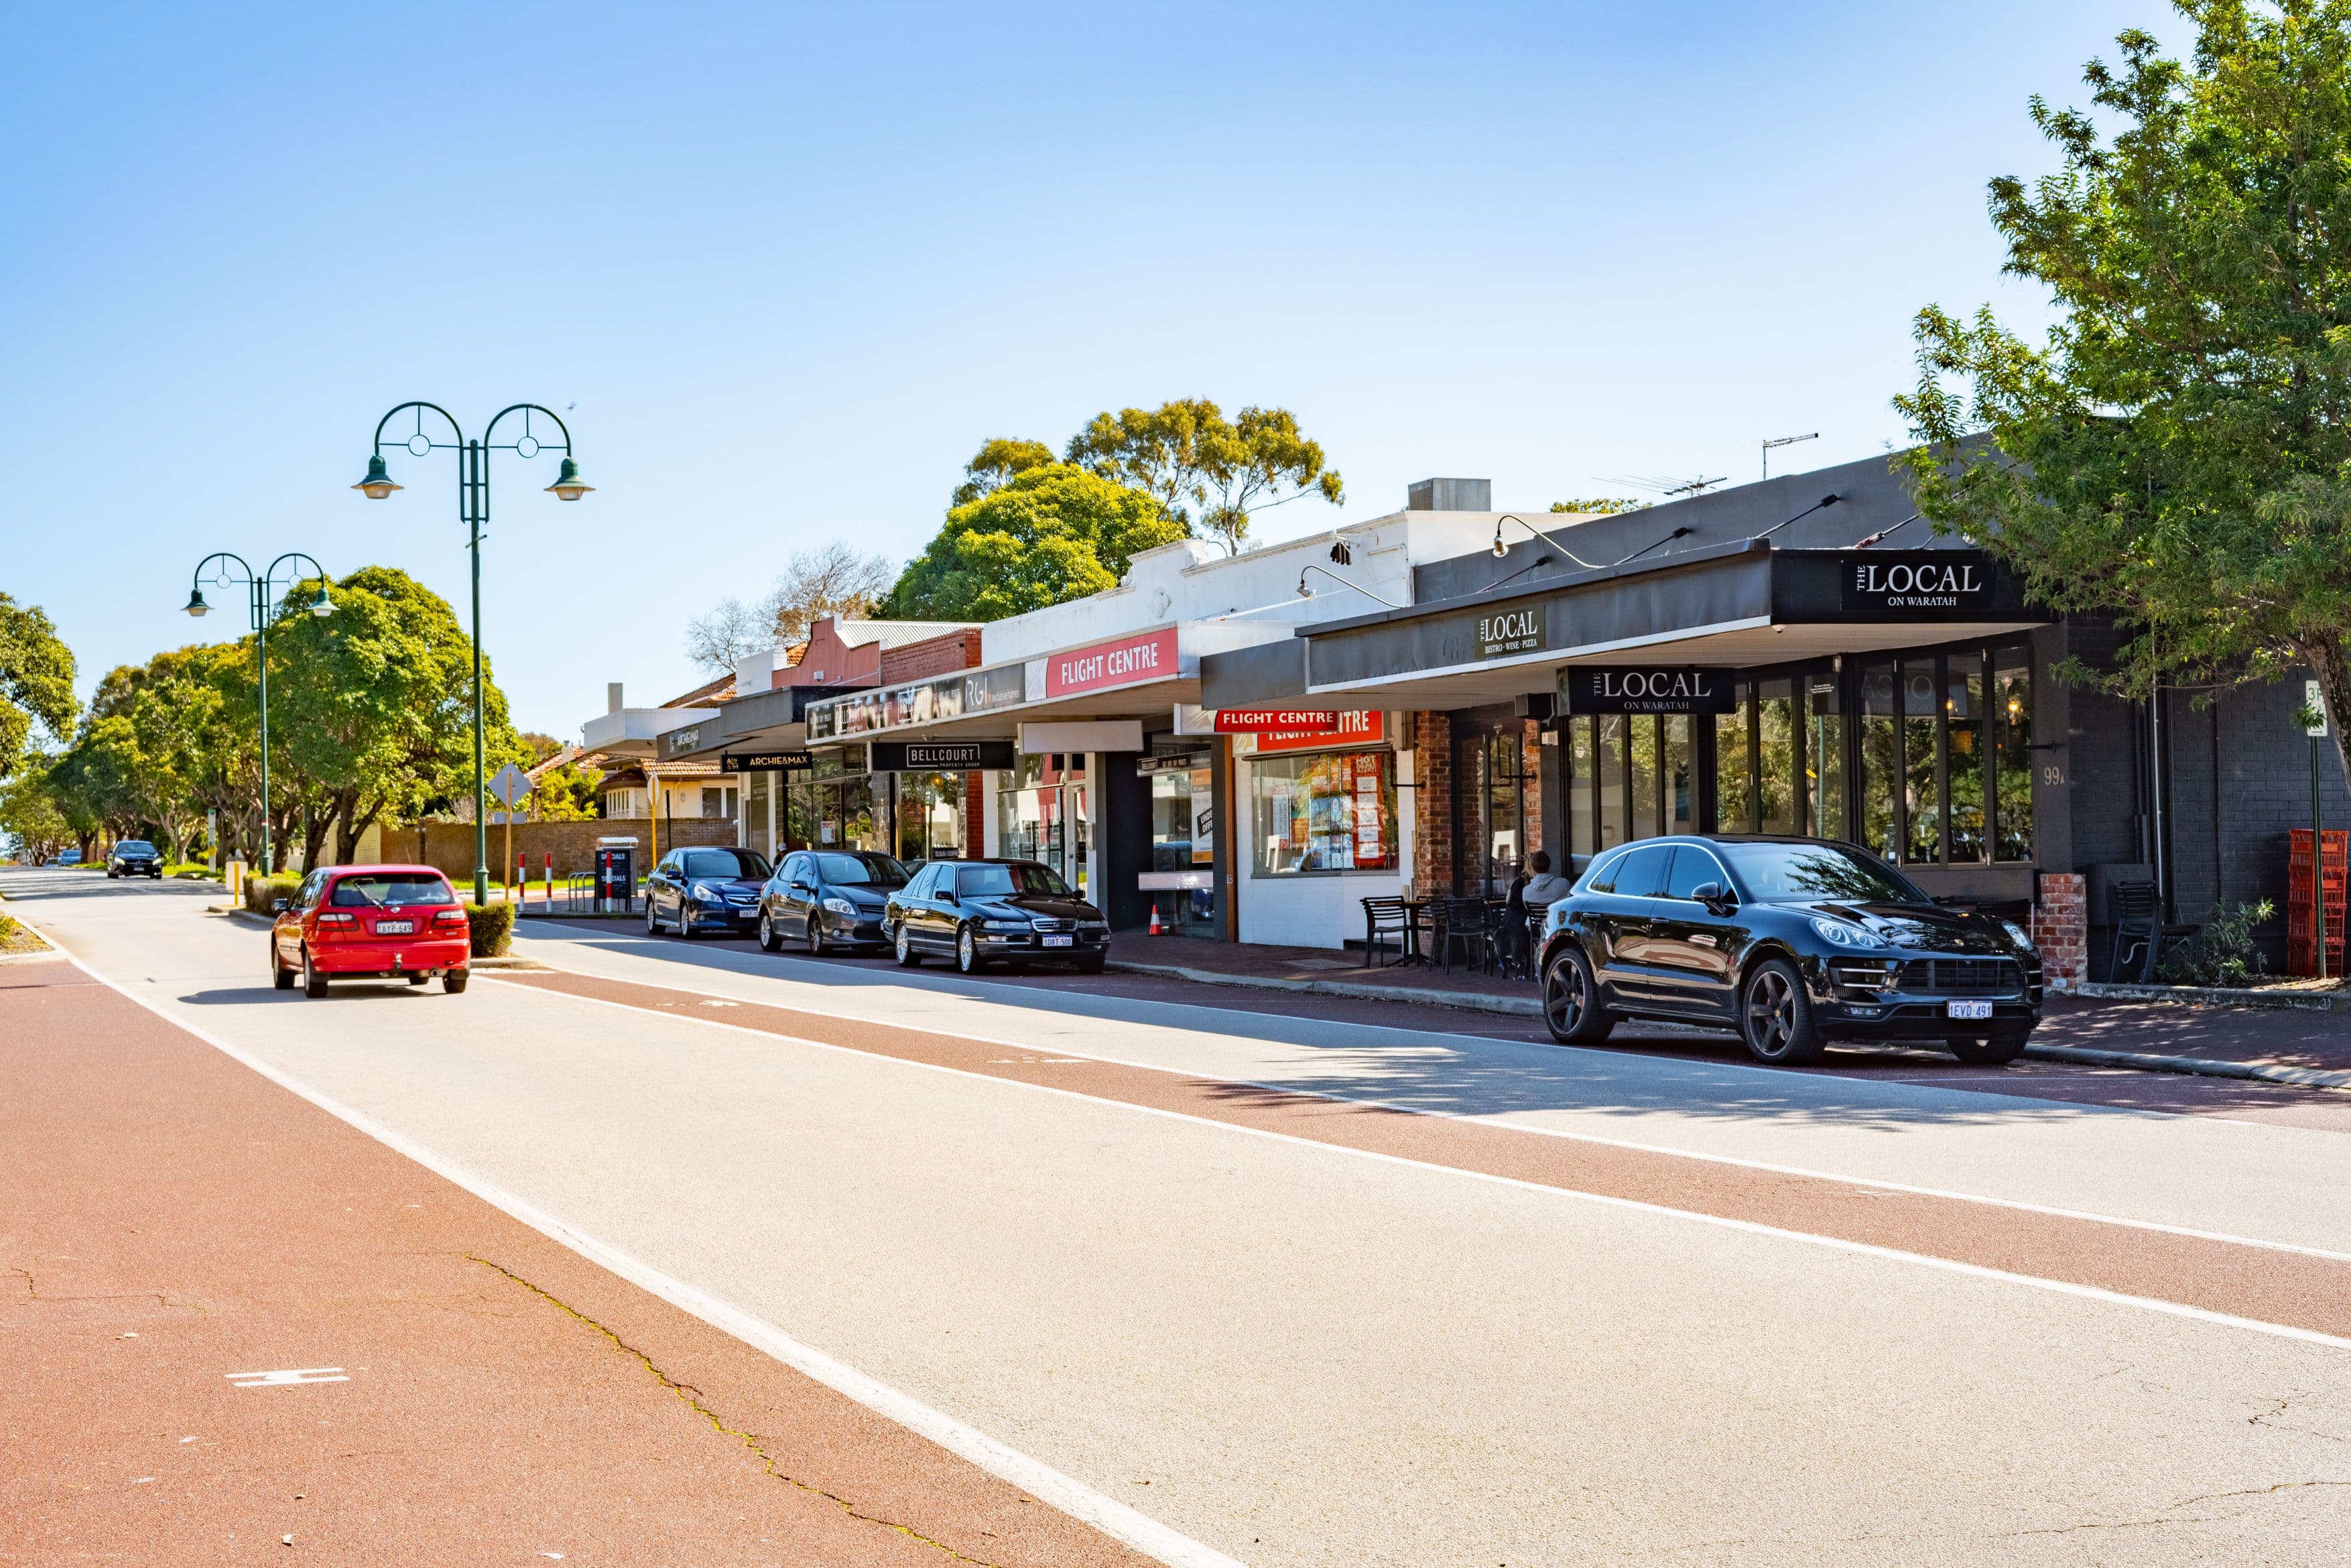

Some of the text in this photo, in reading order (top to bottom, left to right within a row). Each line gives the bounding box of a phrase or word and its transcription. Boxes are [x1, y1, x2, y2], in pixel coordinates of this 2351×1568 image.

[1857, 566, 1865, 591] THE
[1866, 565, 1982, 592] LOCAL
[1888, 596, 1957, 606] ON WARATAH
[1484, 611, 1538, 641] LOCAL
[1485, 639, 1537, 654] BISTRO WINE PIZZA
[1062, 643, 1158, 685] FLIGHT CENTRE
[1593, 673, 1601, 696] THE
[1602, 672, 1712, 697] LOCAL
[1008, 689, 1019, 700] homes
[1625, 702, 1689, 710] ON WARATAH
[1223, 712, 1333, 724] FLIGHT CENTRE
[750, 755, 808, 766] ARCHIE&MAX
[911, 748, 974, 761] BELLCOURT
[1356, 755, 1376, 765] HOT
[1200, 809, 1212, 824] UNDE
[1950, 1005, 1990, 1017] 1EVD 491
